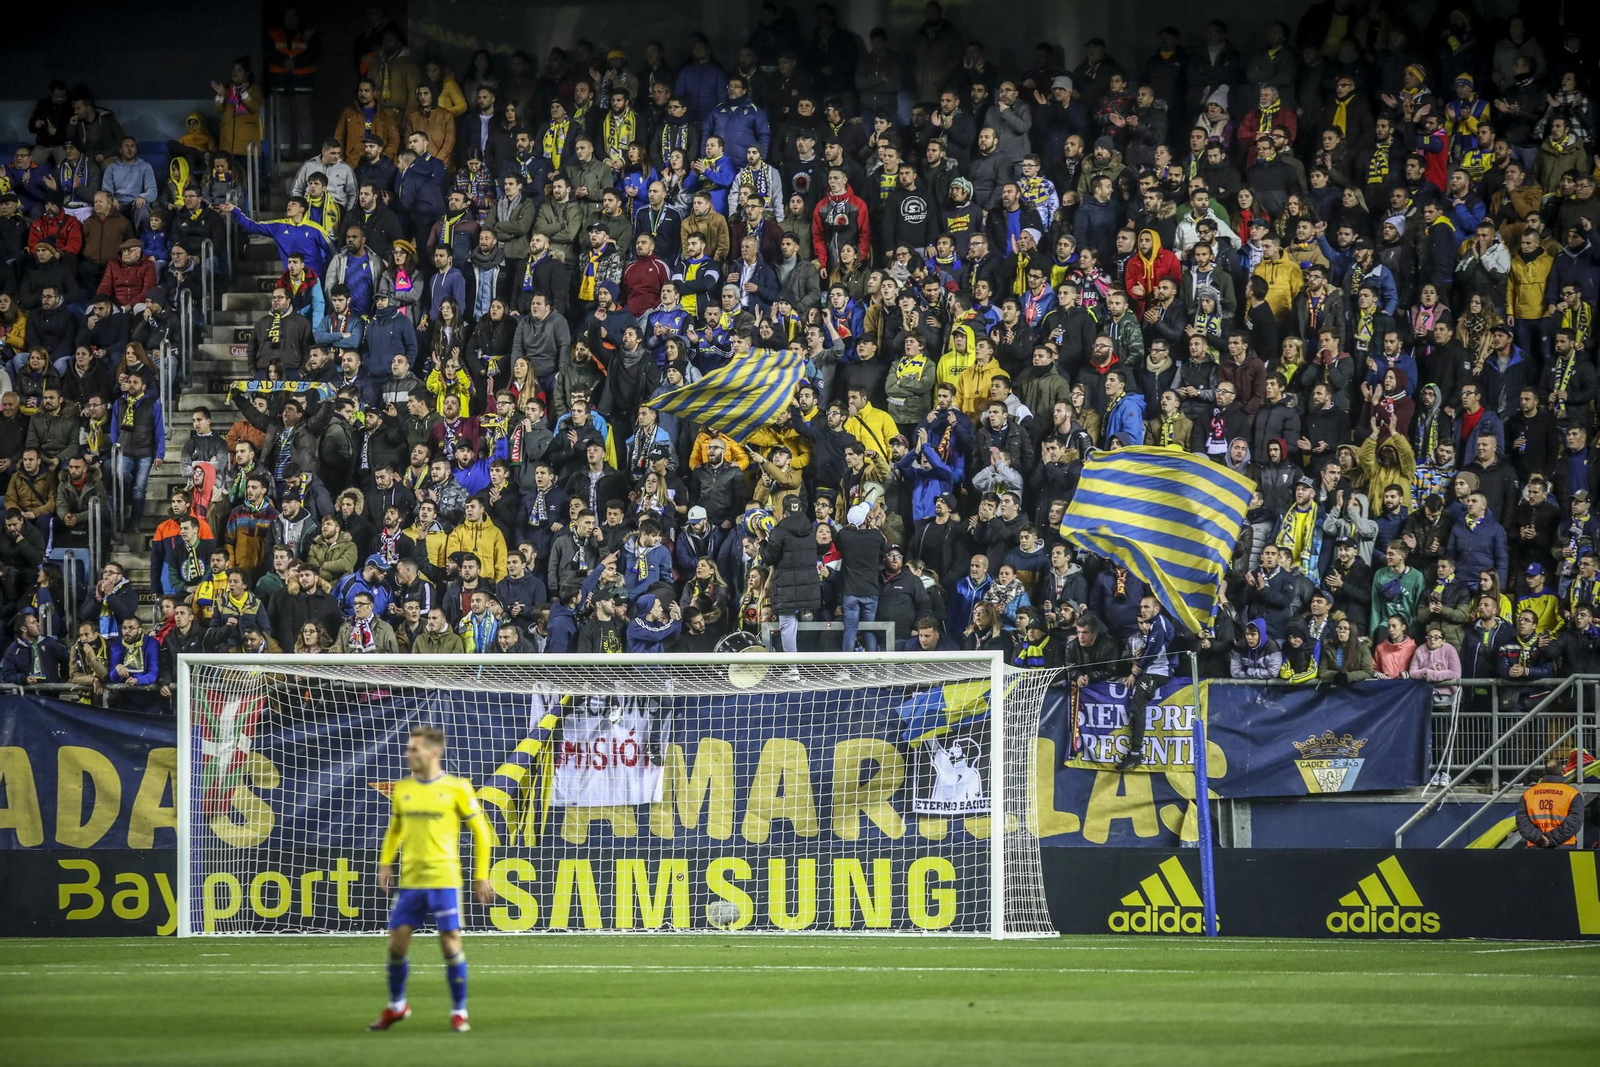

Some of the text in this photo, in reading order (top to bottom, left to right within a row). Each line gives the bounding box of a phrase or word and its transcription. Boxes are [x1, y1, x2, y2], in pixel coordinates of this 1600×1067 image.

[1533, 788, 1564, 796] SEGURIDAD
[914, 800, 957, 811] ETERNO
[1539, 800, 1553, 810] 026
[490, 856, 957, 931] SAMSUNG
[1326, 905, 1441, 933] adidas
